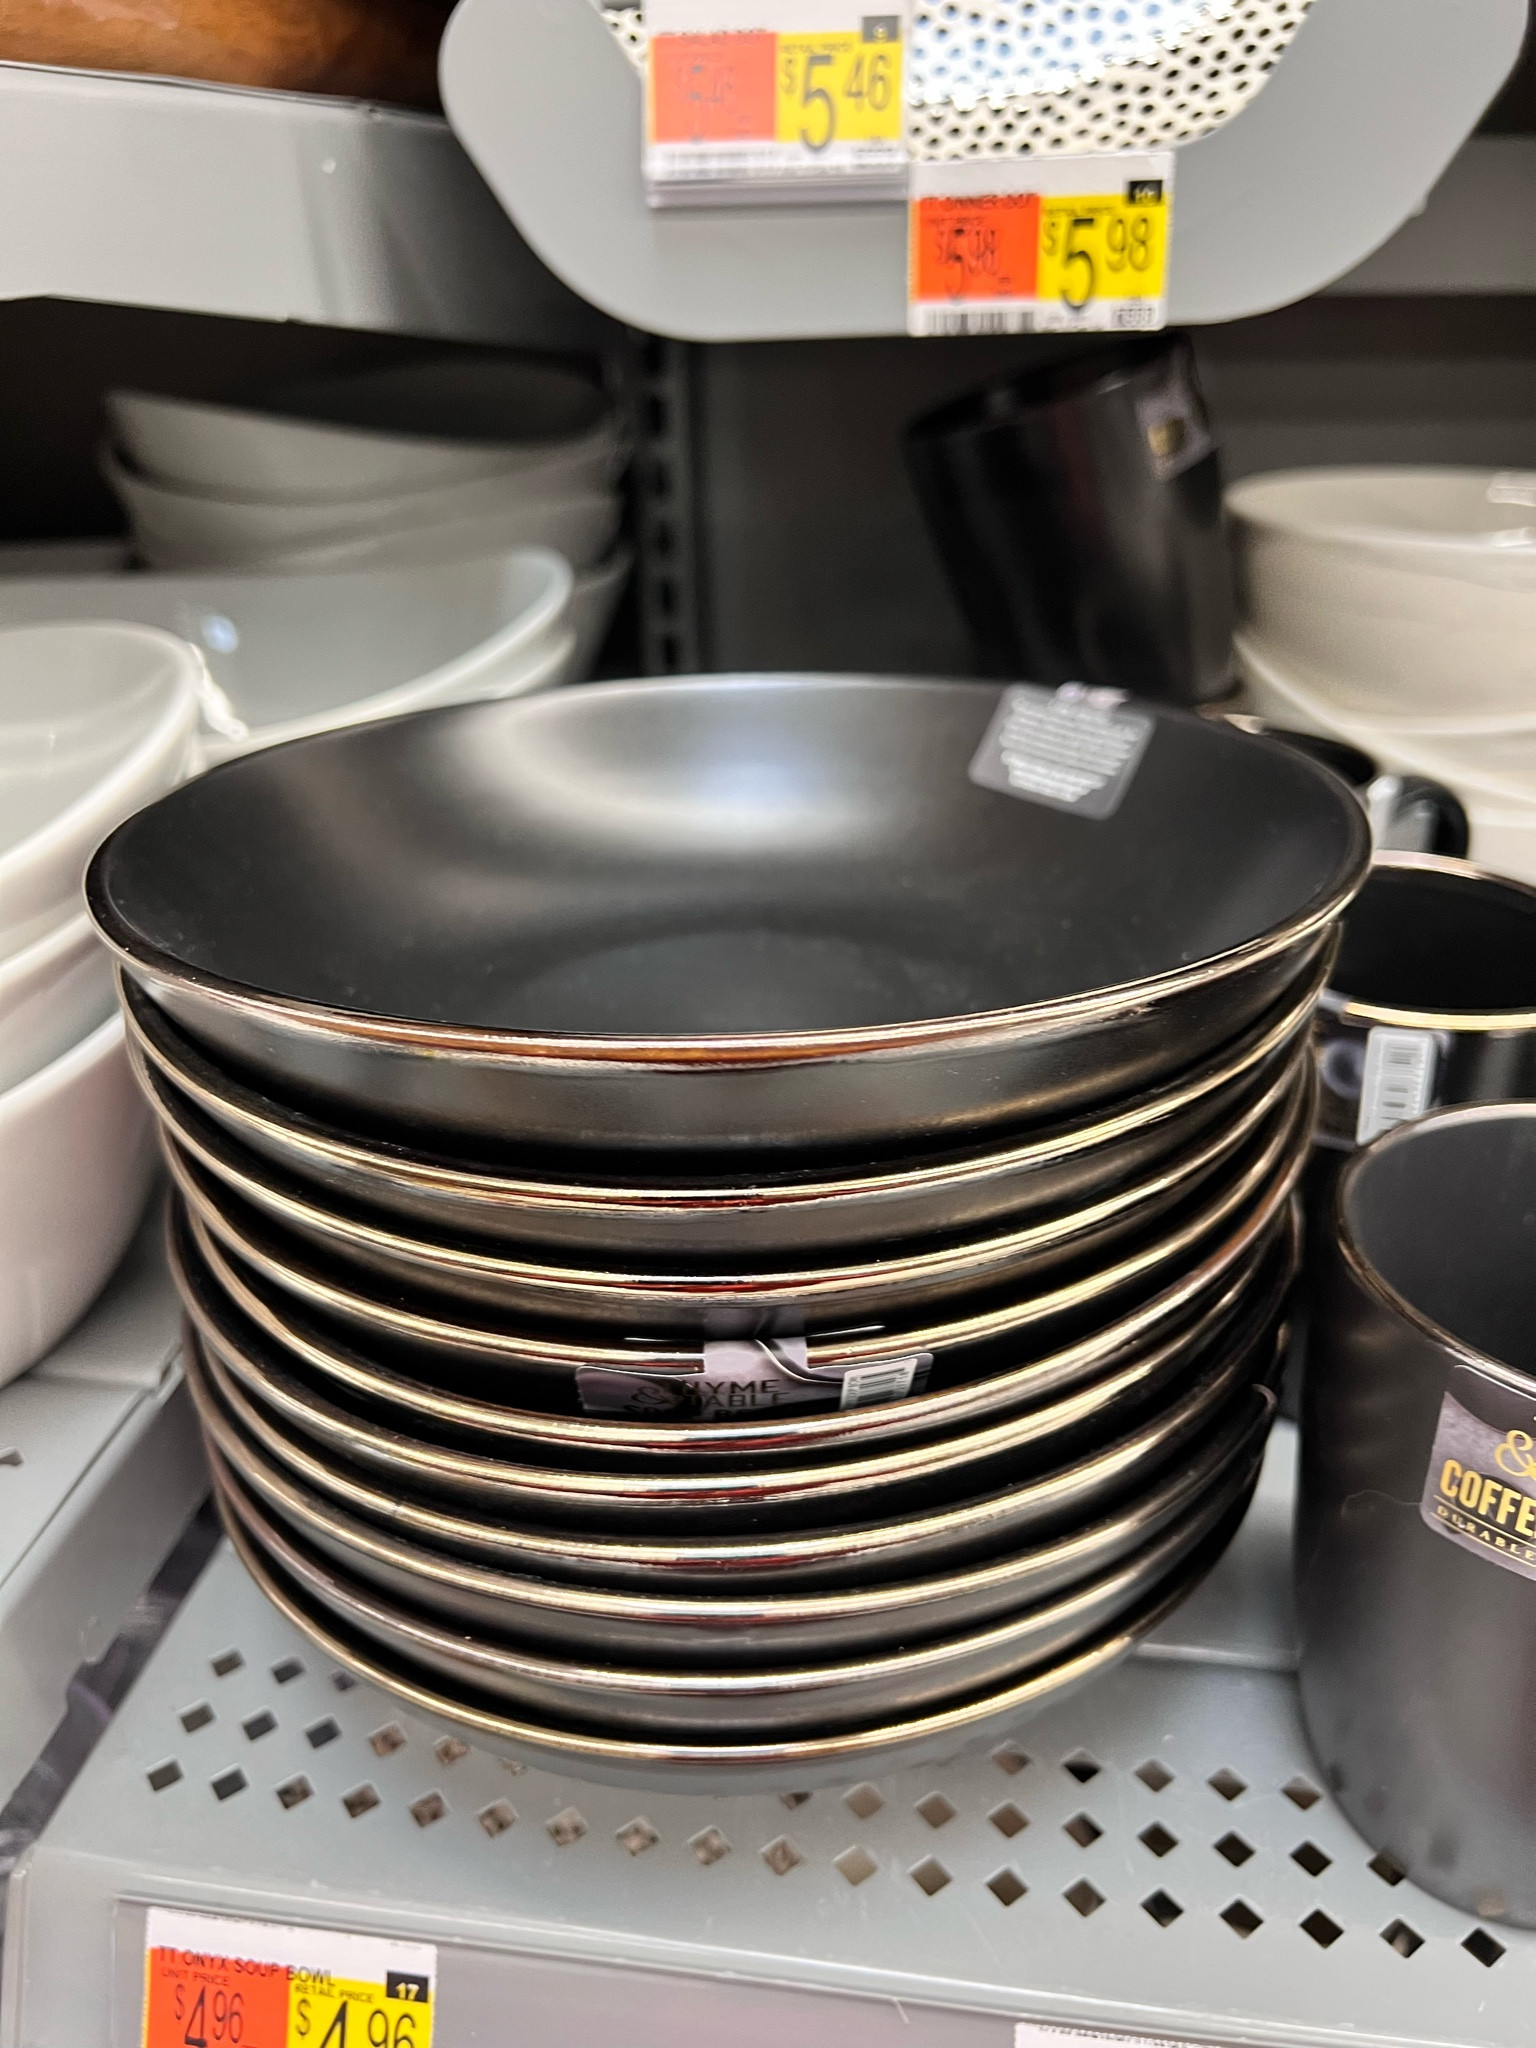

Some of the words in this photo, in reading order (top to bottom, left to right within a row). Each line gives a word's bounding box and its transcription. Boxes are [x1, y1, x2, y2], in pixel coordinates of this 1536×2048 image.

[1440, 1459, 1536, 1538] COFFE
[1437, 1505, 1536, 1560] DURABLE
[162, 1967, 189, 1980] UNIT
[192, 1971, 230, 1986] PRICE
[181, 1949, 230, 1971] ONYX
[233, 1957, 281, 1977] SOUP
[285, 1964, 336, 1988] BOWL
[294, 1983, 337, 1998] RETAIL
[339, 1989, 375, 2003] PRICE
[395, 1981, 421, 2001] 17
